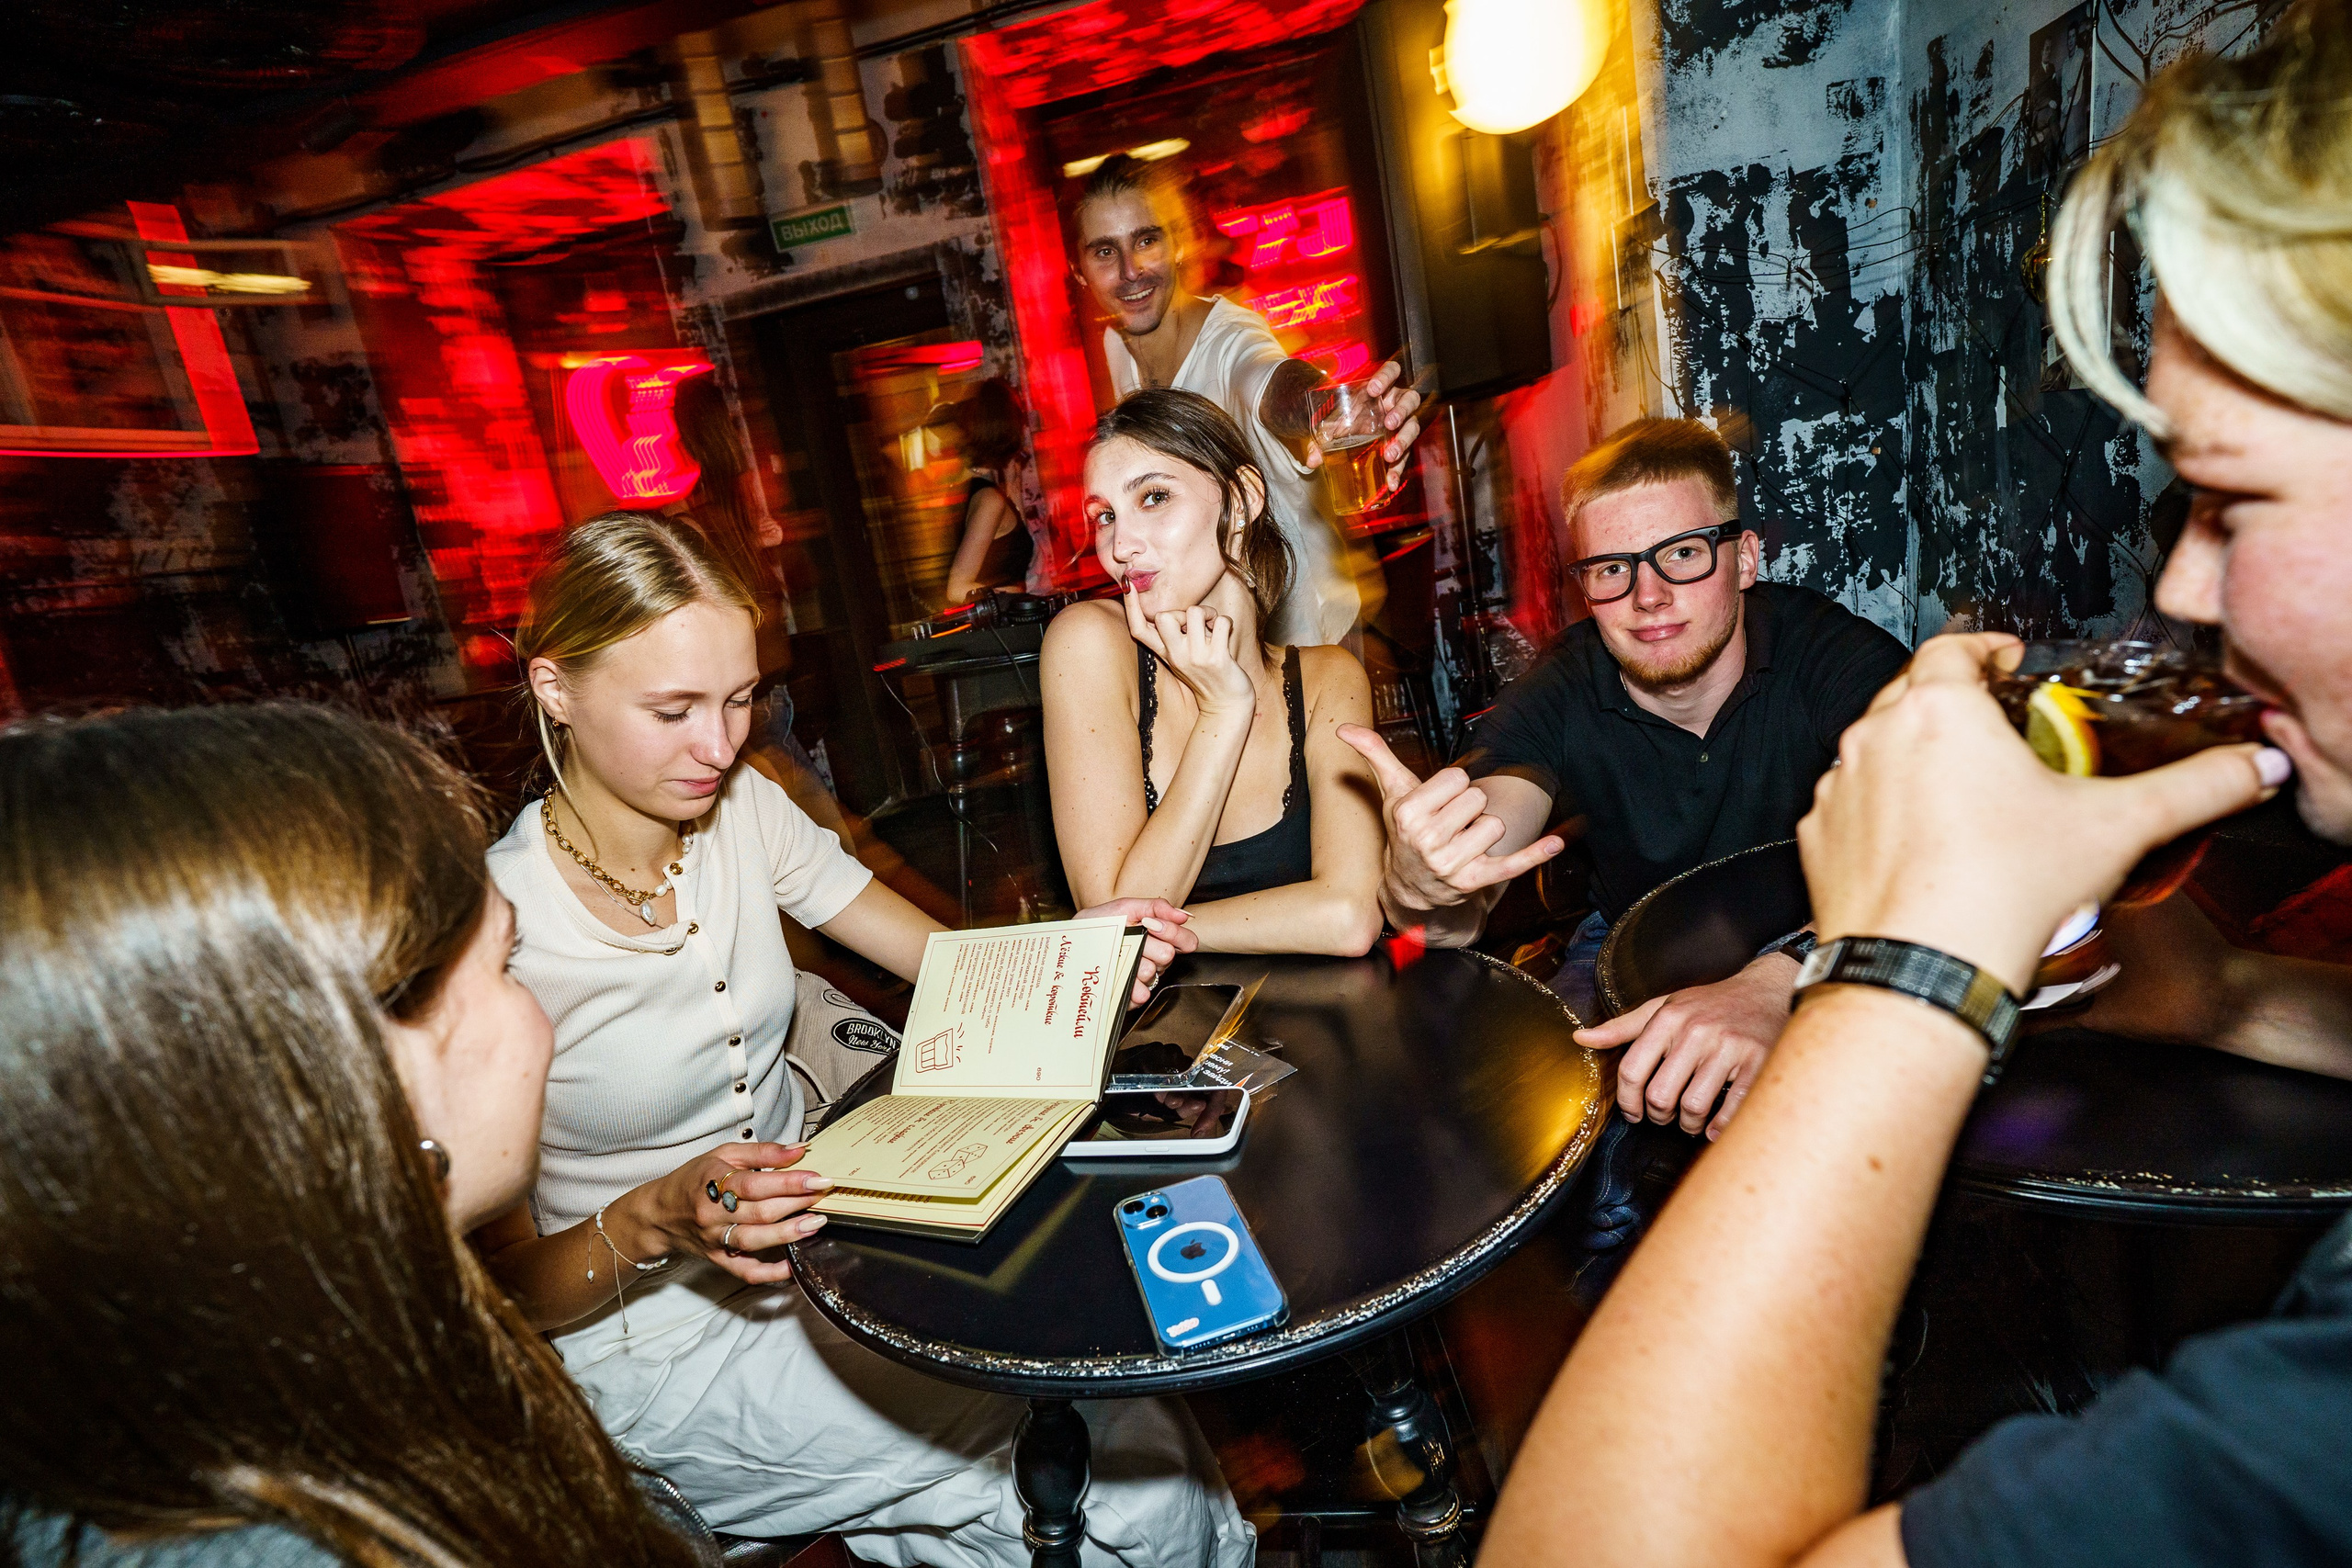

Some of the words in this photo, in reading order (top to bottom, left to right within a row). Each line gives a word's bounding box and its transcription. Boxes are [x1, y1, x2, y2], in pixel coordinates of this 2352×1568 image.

[780, 212, 844, 241] ВЫХОД
[1056, 935, 1072, 968] Лёгкие
[1023, 953, 1034, 984] любимый
[1053, 971, 1065, 981] &
[989, 981, 1000, 1010] помнить
[1044, 985, 1061, 1025] короткие
[1073, 965, 1100, 1038] Коктейли
[846, 1022, 897, 1049] BROOKLYN
[848, 1034, 869, 1046] New
[1209, 1053, 1234, 1067] вони
